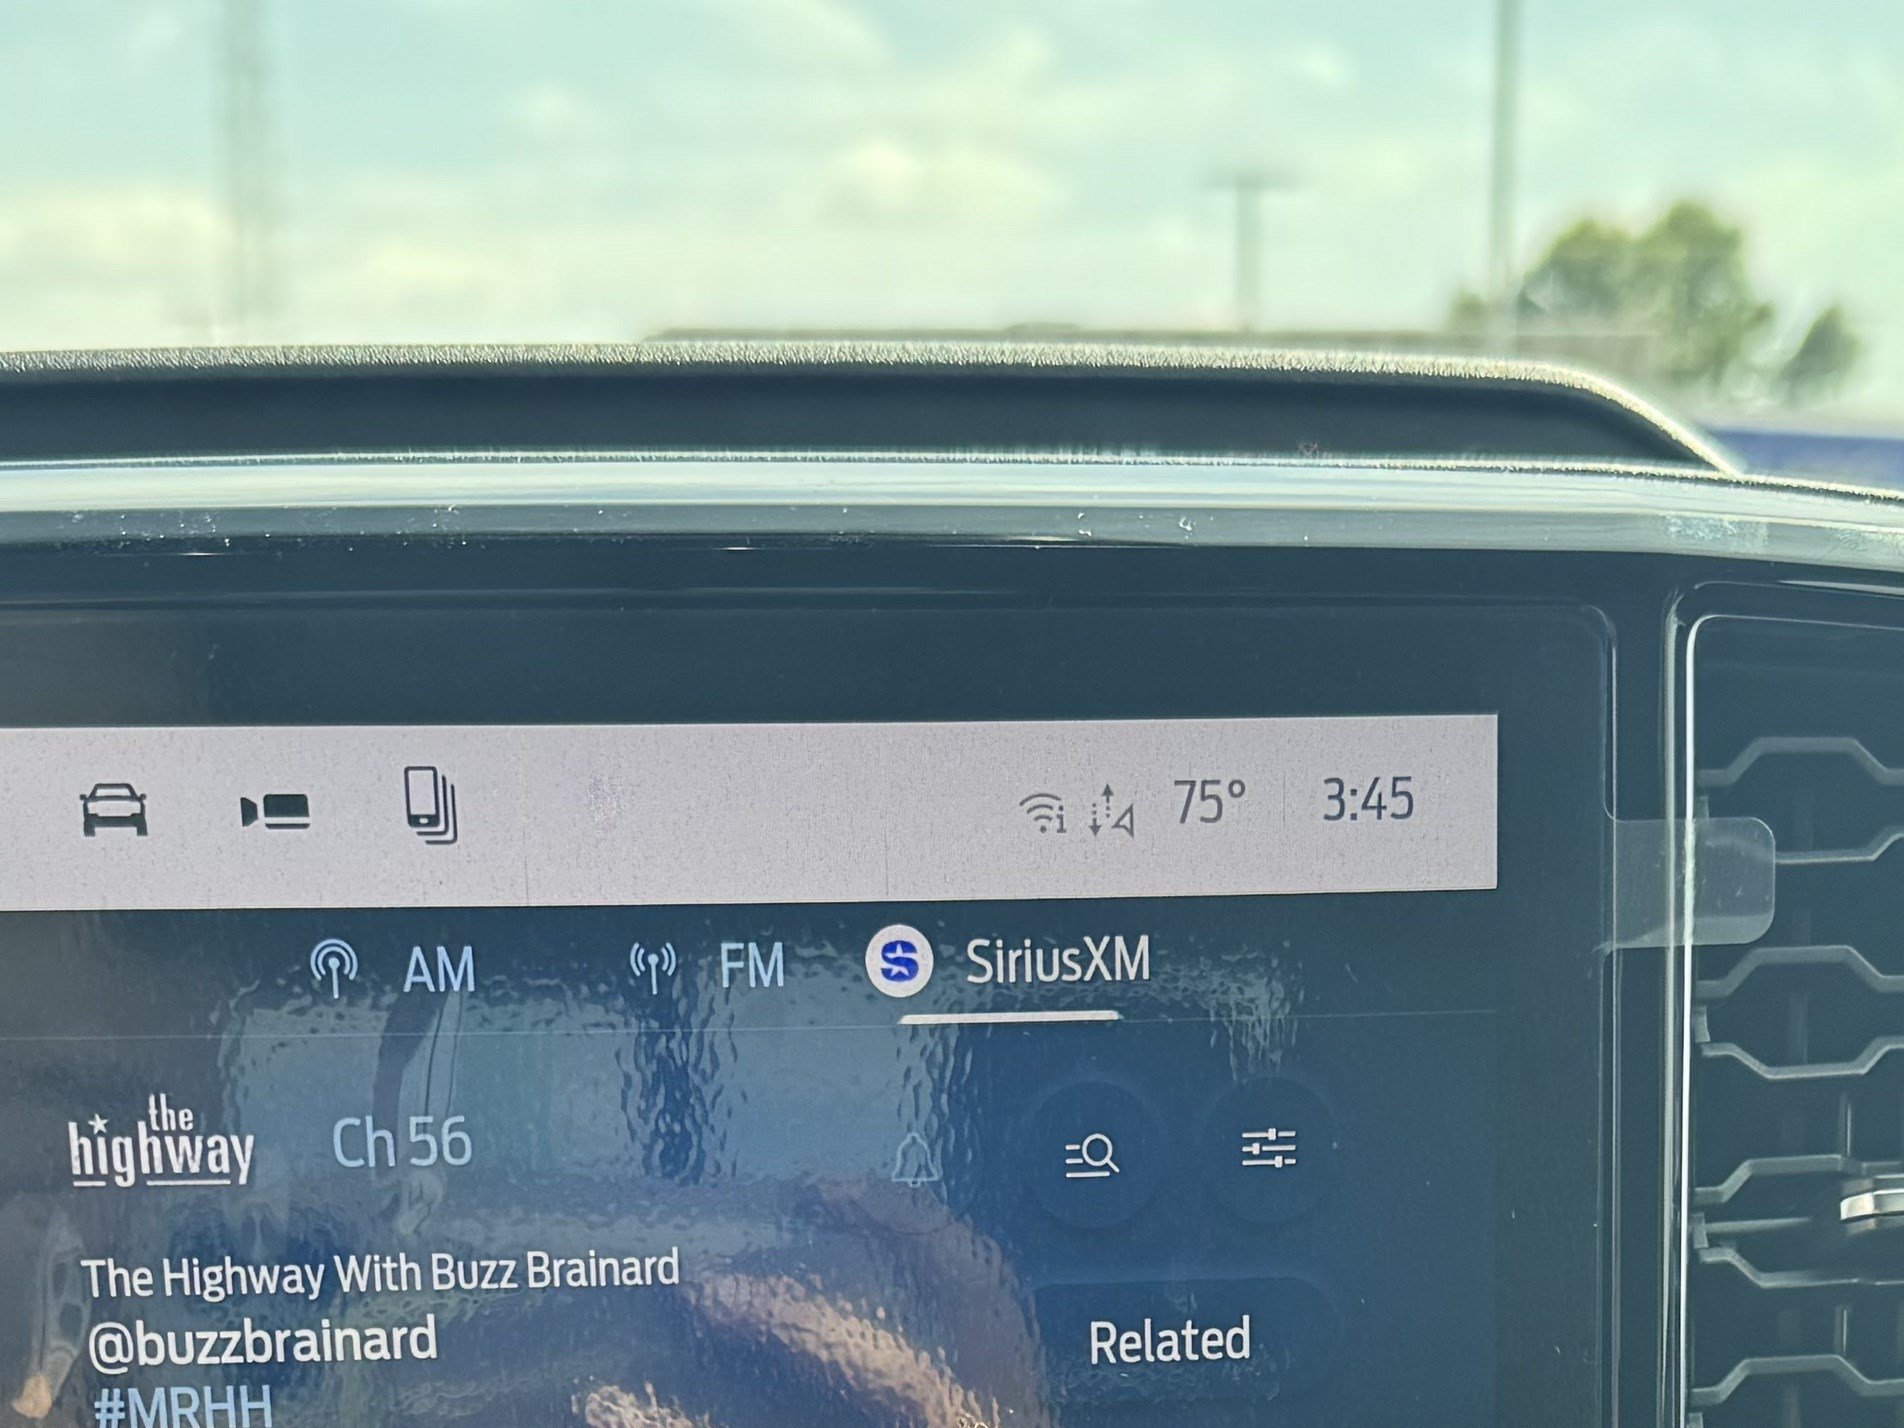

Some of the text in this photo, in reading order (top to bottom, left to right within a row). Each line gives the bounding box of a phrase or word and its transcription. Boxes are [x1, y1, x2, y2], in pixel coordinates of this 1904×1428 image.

[1173, 778, 1246, 825] 75°
[1322, 775, 1415, 822] 3:45
[402, 945, 475, 993] AM
[720, 941, 785, 988] FM
[966, 934, 1151, 985] SiriusXM
[147, 1092, 195, 1132] the
[67, 1115, 255, 1188] highway
[332, 1115, 473, 1169] Ch 56
[80, 1246, 680, 1303] The Highway With Buzz Brainard
[88, 1313, 438, 1376] @buzzbrainard
[1090, 1314, 1251, 1365] Related
